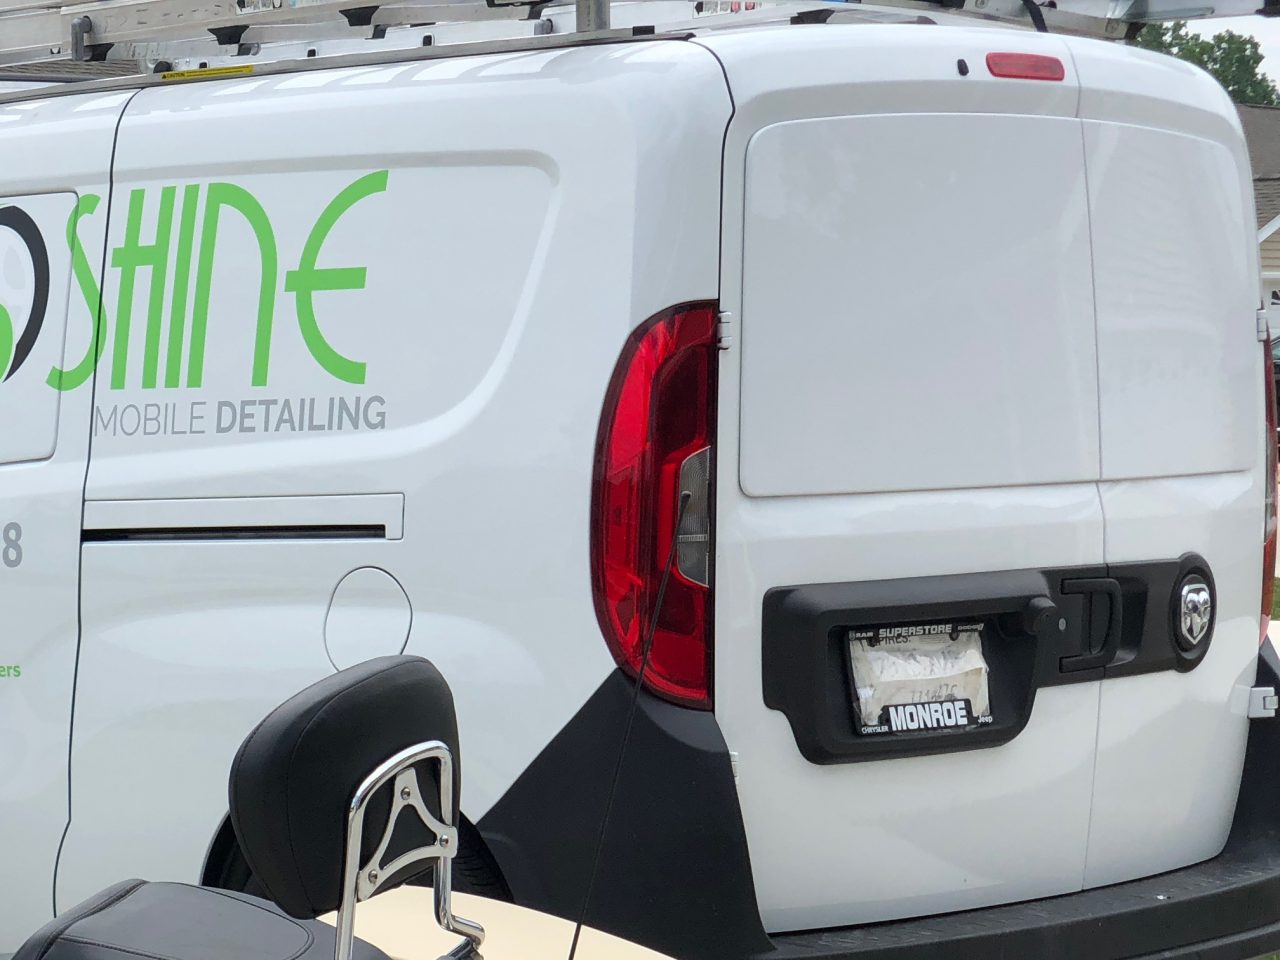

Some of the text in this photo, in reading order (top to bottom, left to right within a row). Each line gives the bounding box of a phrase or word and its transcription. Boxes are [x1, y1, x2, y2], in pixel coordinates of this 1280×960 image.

[94, 395, 387, 437] MOBILE DETAILING
[878, 624, 953, 638] SUPERSTORE
[888, 701, 968, 731] MONROE
[978, 715, 993, 724] Jeep
[862, 725, 889, 734] CHRYSLER
